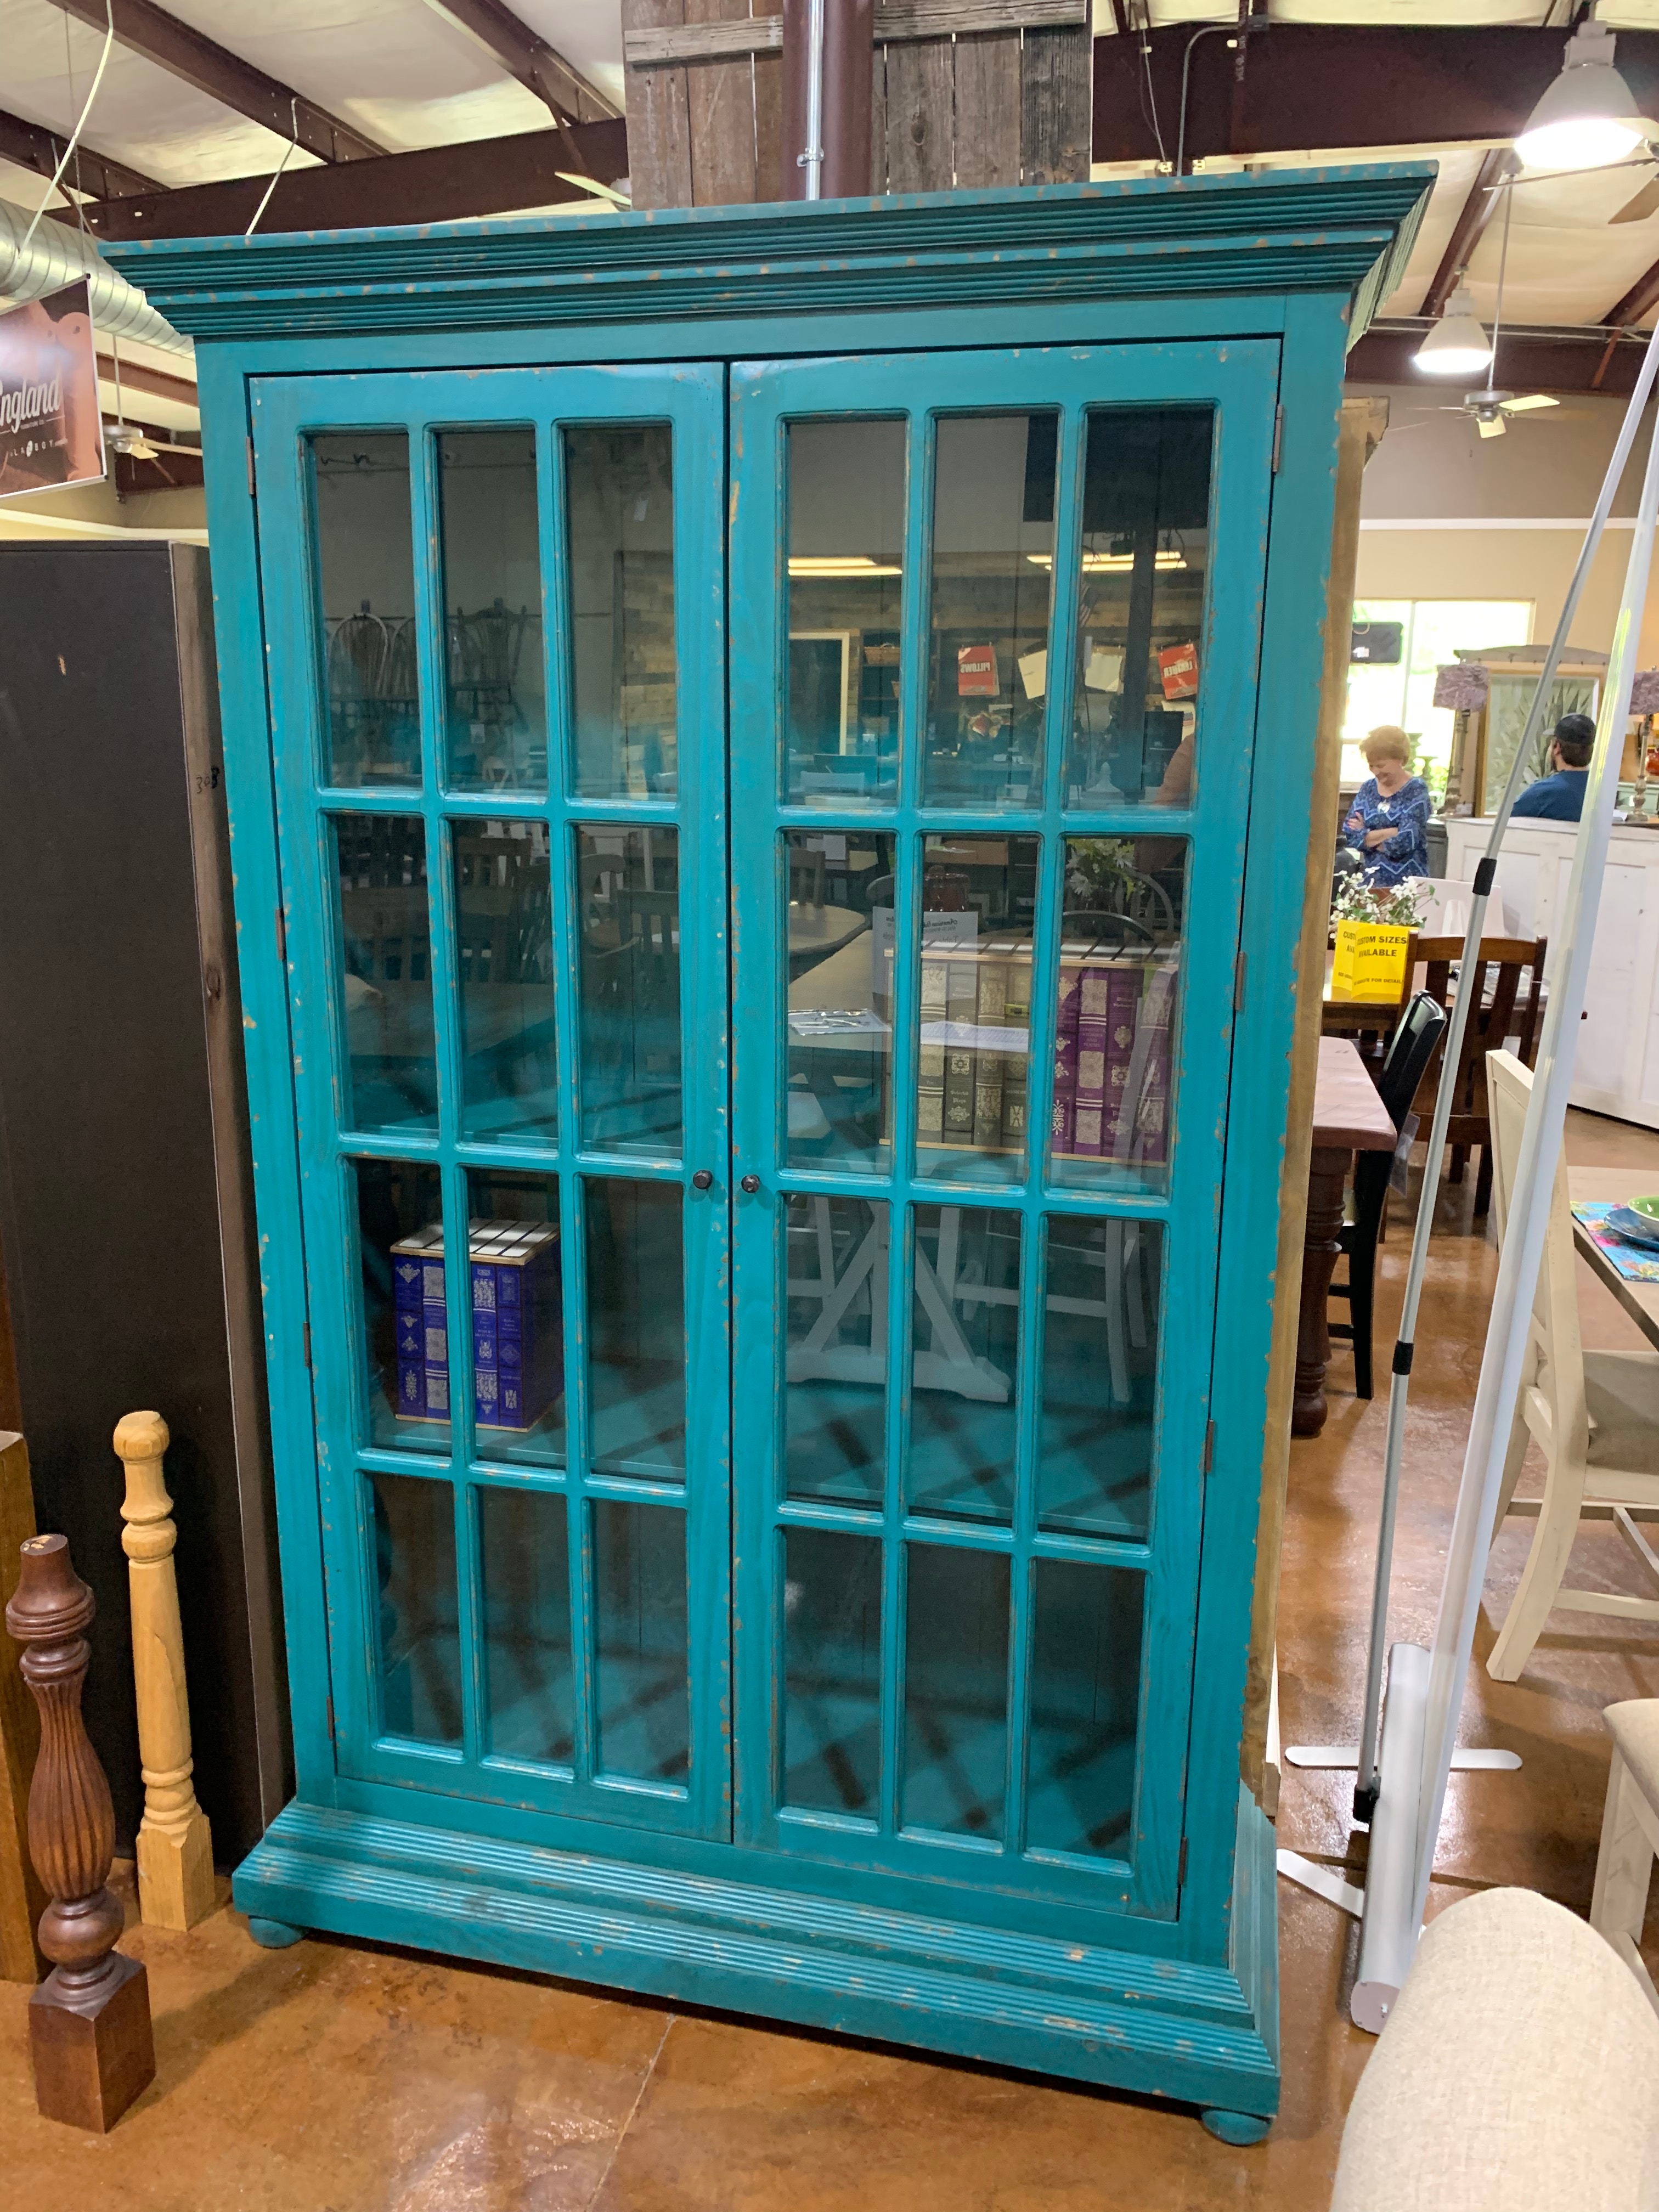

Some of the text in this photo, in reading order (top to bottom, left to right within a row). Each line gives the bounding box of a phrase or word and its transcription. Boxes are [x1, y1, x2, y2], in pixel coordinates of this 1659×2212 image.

[1343, 931, 1356, 940] CUST
[1378, 936, 1407, 944] SIZES
[1358, 949, 1397, 957] AVAILABLE
